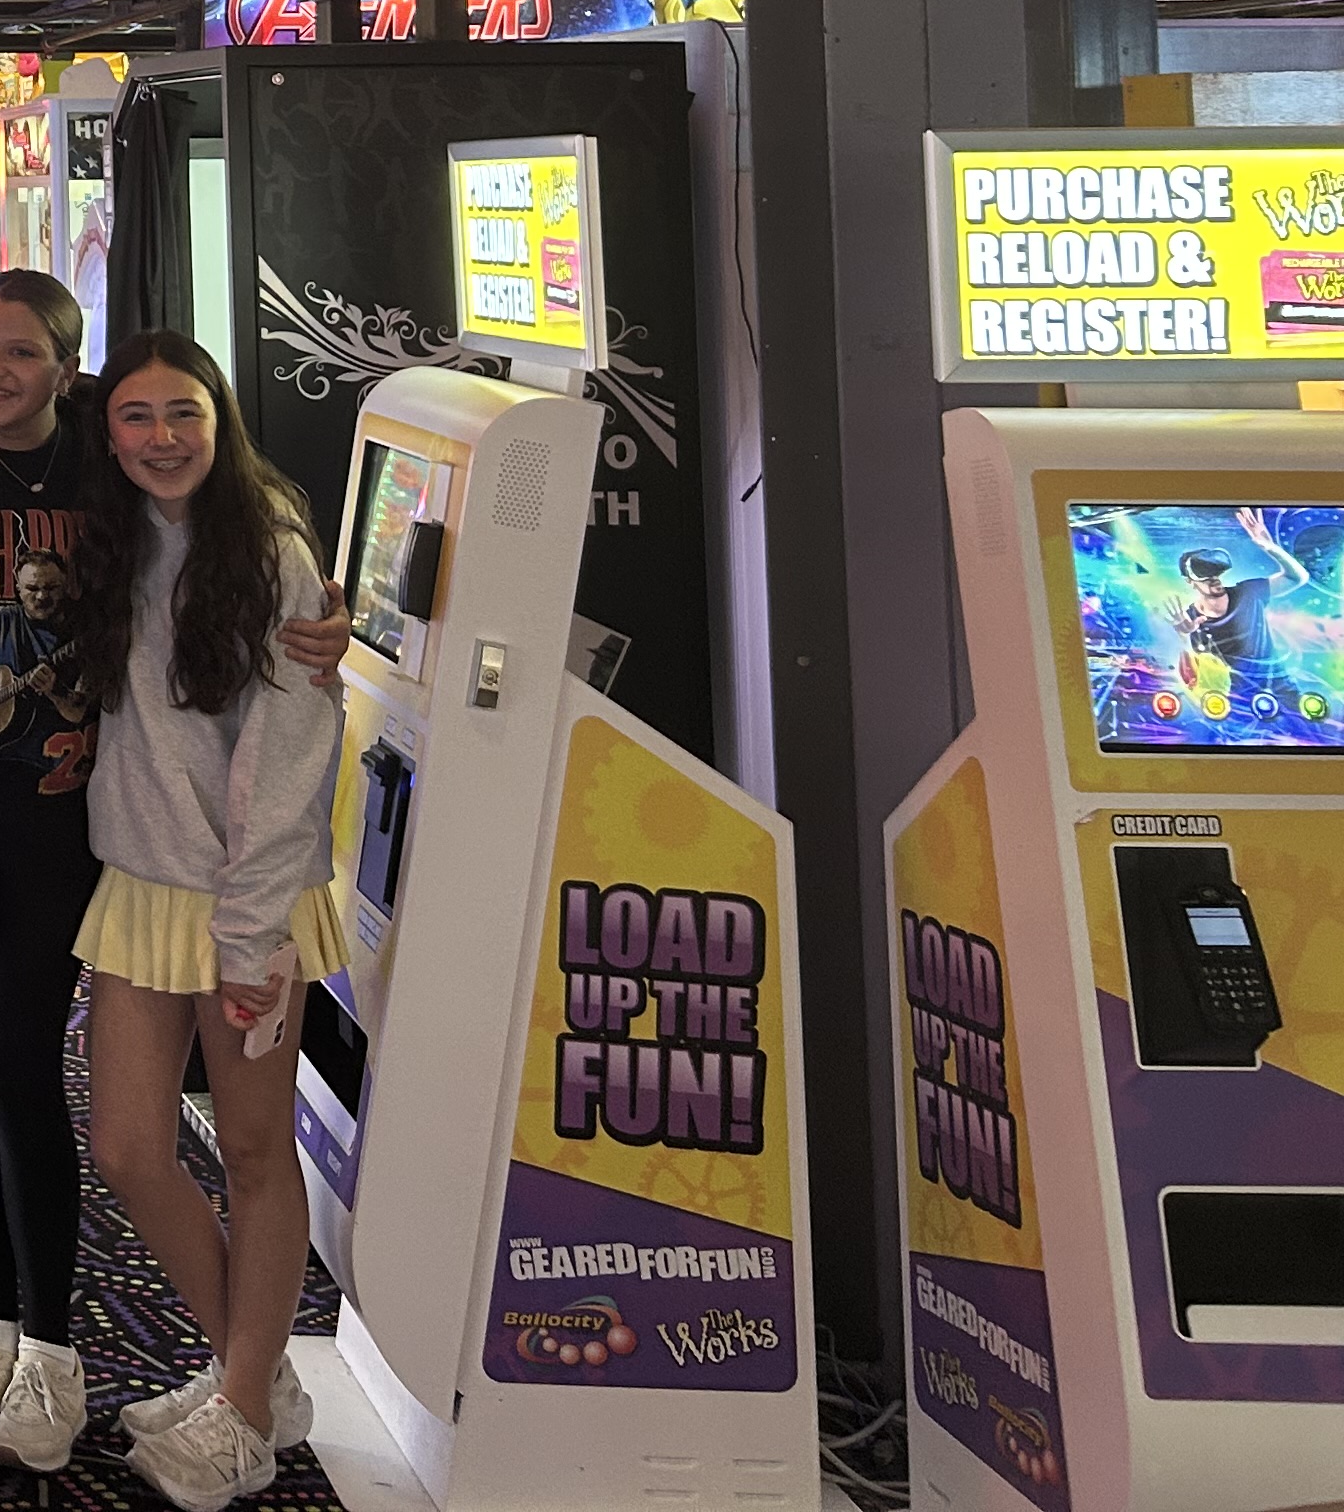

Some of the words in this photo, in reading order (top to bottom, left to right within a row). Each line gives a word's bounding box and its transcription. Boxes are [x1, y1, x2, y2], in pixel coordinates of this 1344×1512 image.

[963, 165, 1235, 223] PURCHASE
[967, 231, 1157, 288] RELOAD
[1166, 230, 1216, 288] &
[970, 297, 1230, 356] REGISTER!
[1112, 815, 1173, 836] CREDIT
[1174, 815, 1222, 836] CARD
[560, 880, 765, 983] LOAD
[902, 908, 1005, 1039] LOAD
[564, 972, 647, 1032] UP
[648, 978, 759, 1048] THE
[912, 1002, 951, 1075] UP
[951, 1018, 1008, 1112] THE
[555, 1033, 767, 1155] FUN!
[914, 1066, 1022, 1230] FUN!
[503, 1311, 606, 1331] Ballocity
[656, 1308, 779, 1367] Works
